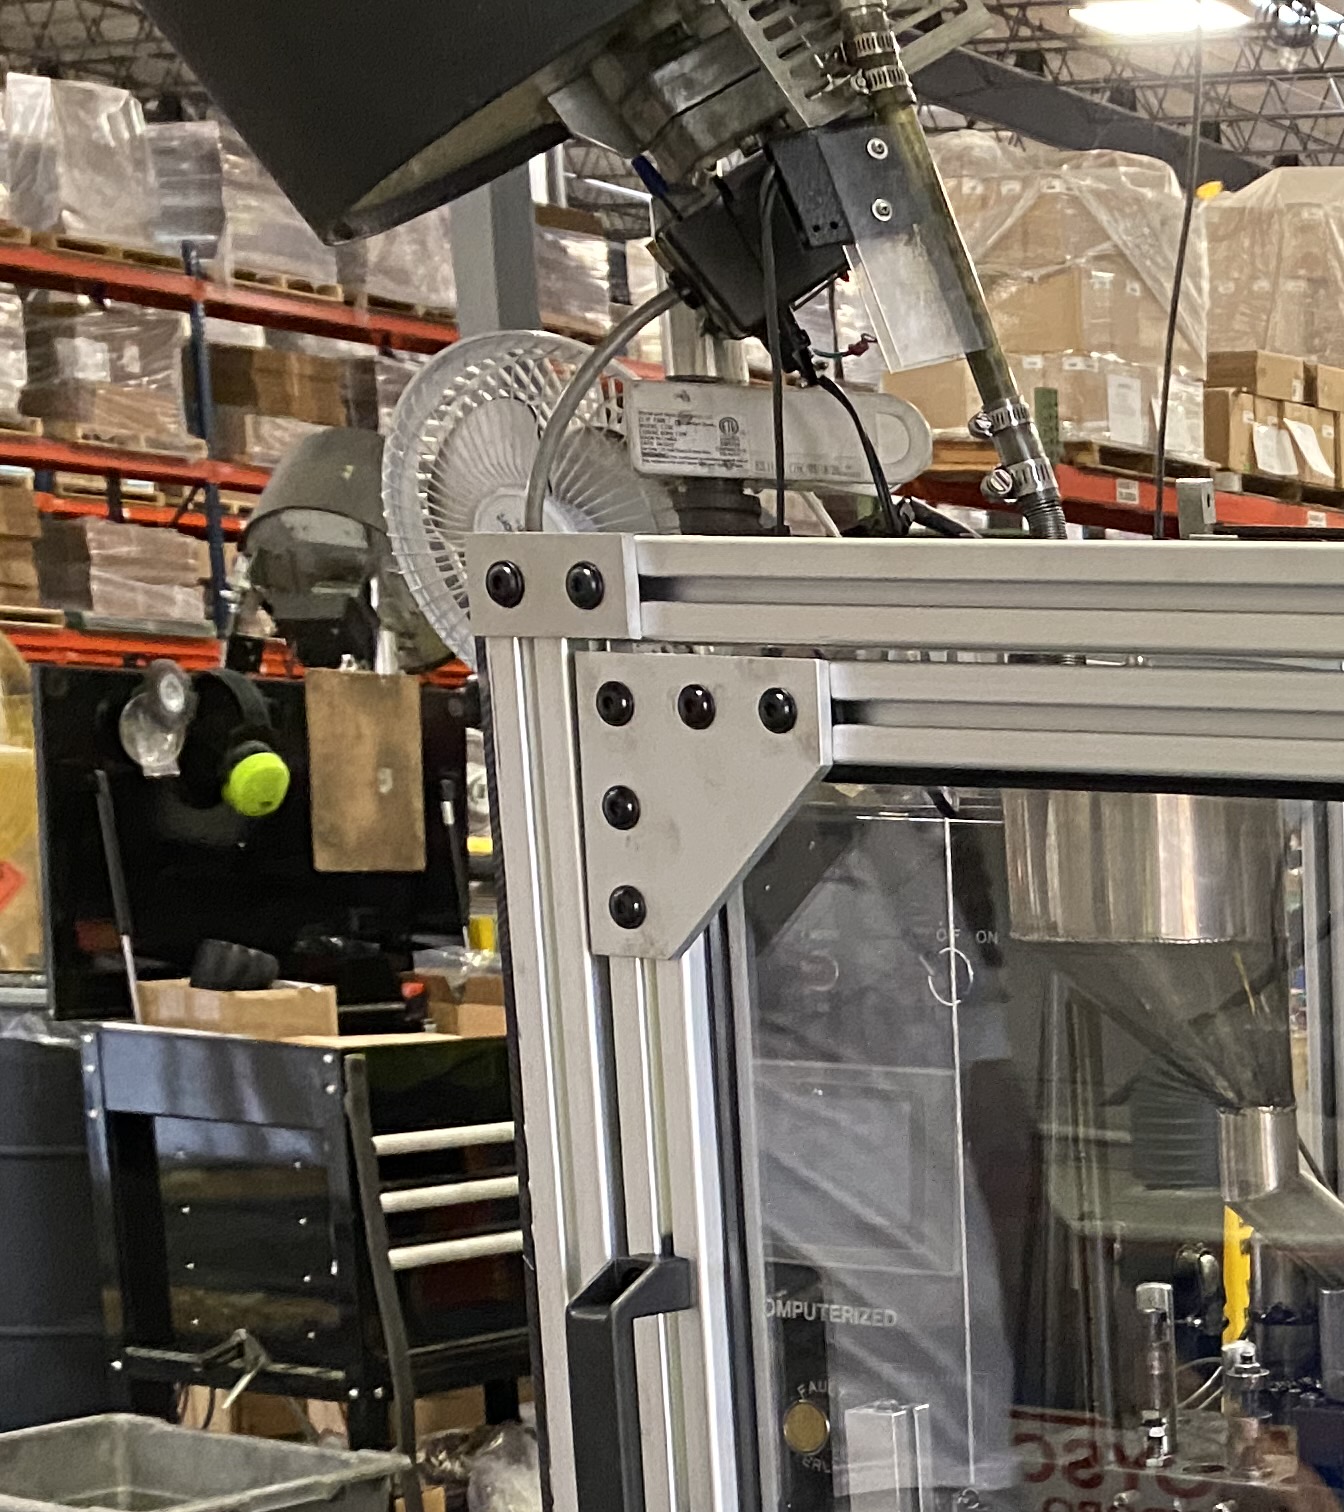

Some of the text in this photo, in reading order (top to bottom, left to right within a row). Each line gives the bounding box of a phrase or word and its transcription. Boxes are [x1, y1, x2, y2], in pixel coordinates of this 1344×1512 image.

[935, 927, 1000, 945] OF ON
[765, 1297, 897, 1328] OMPUTERIZED
